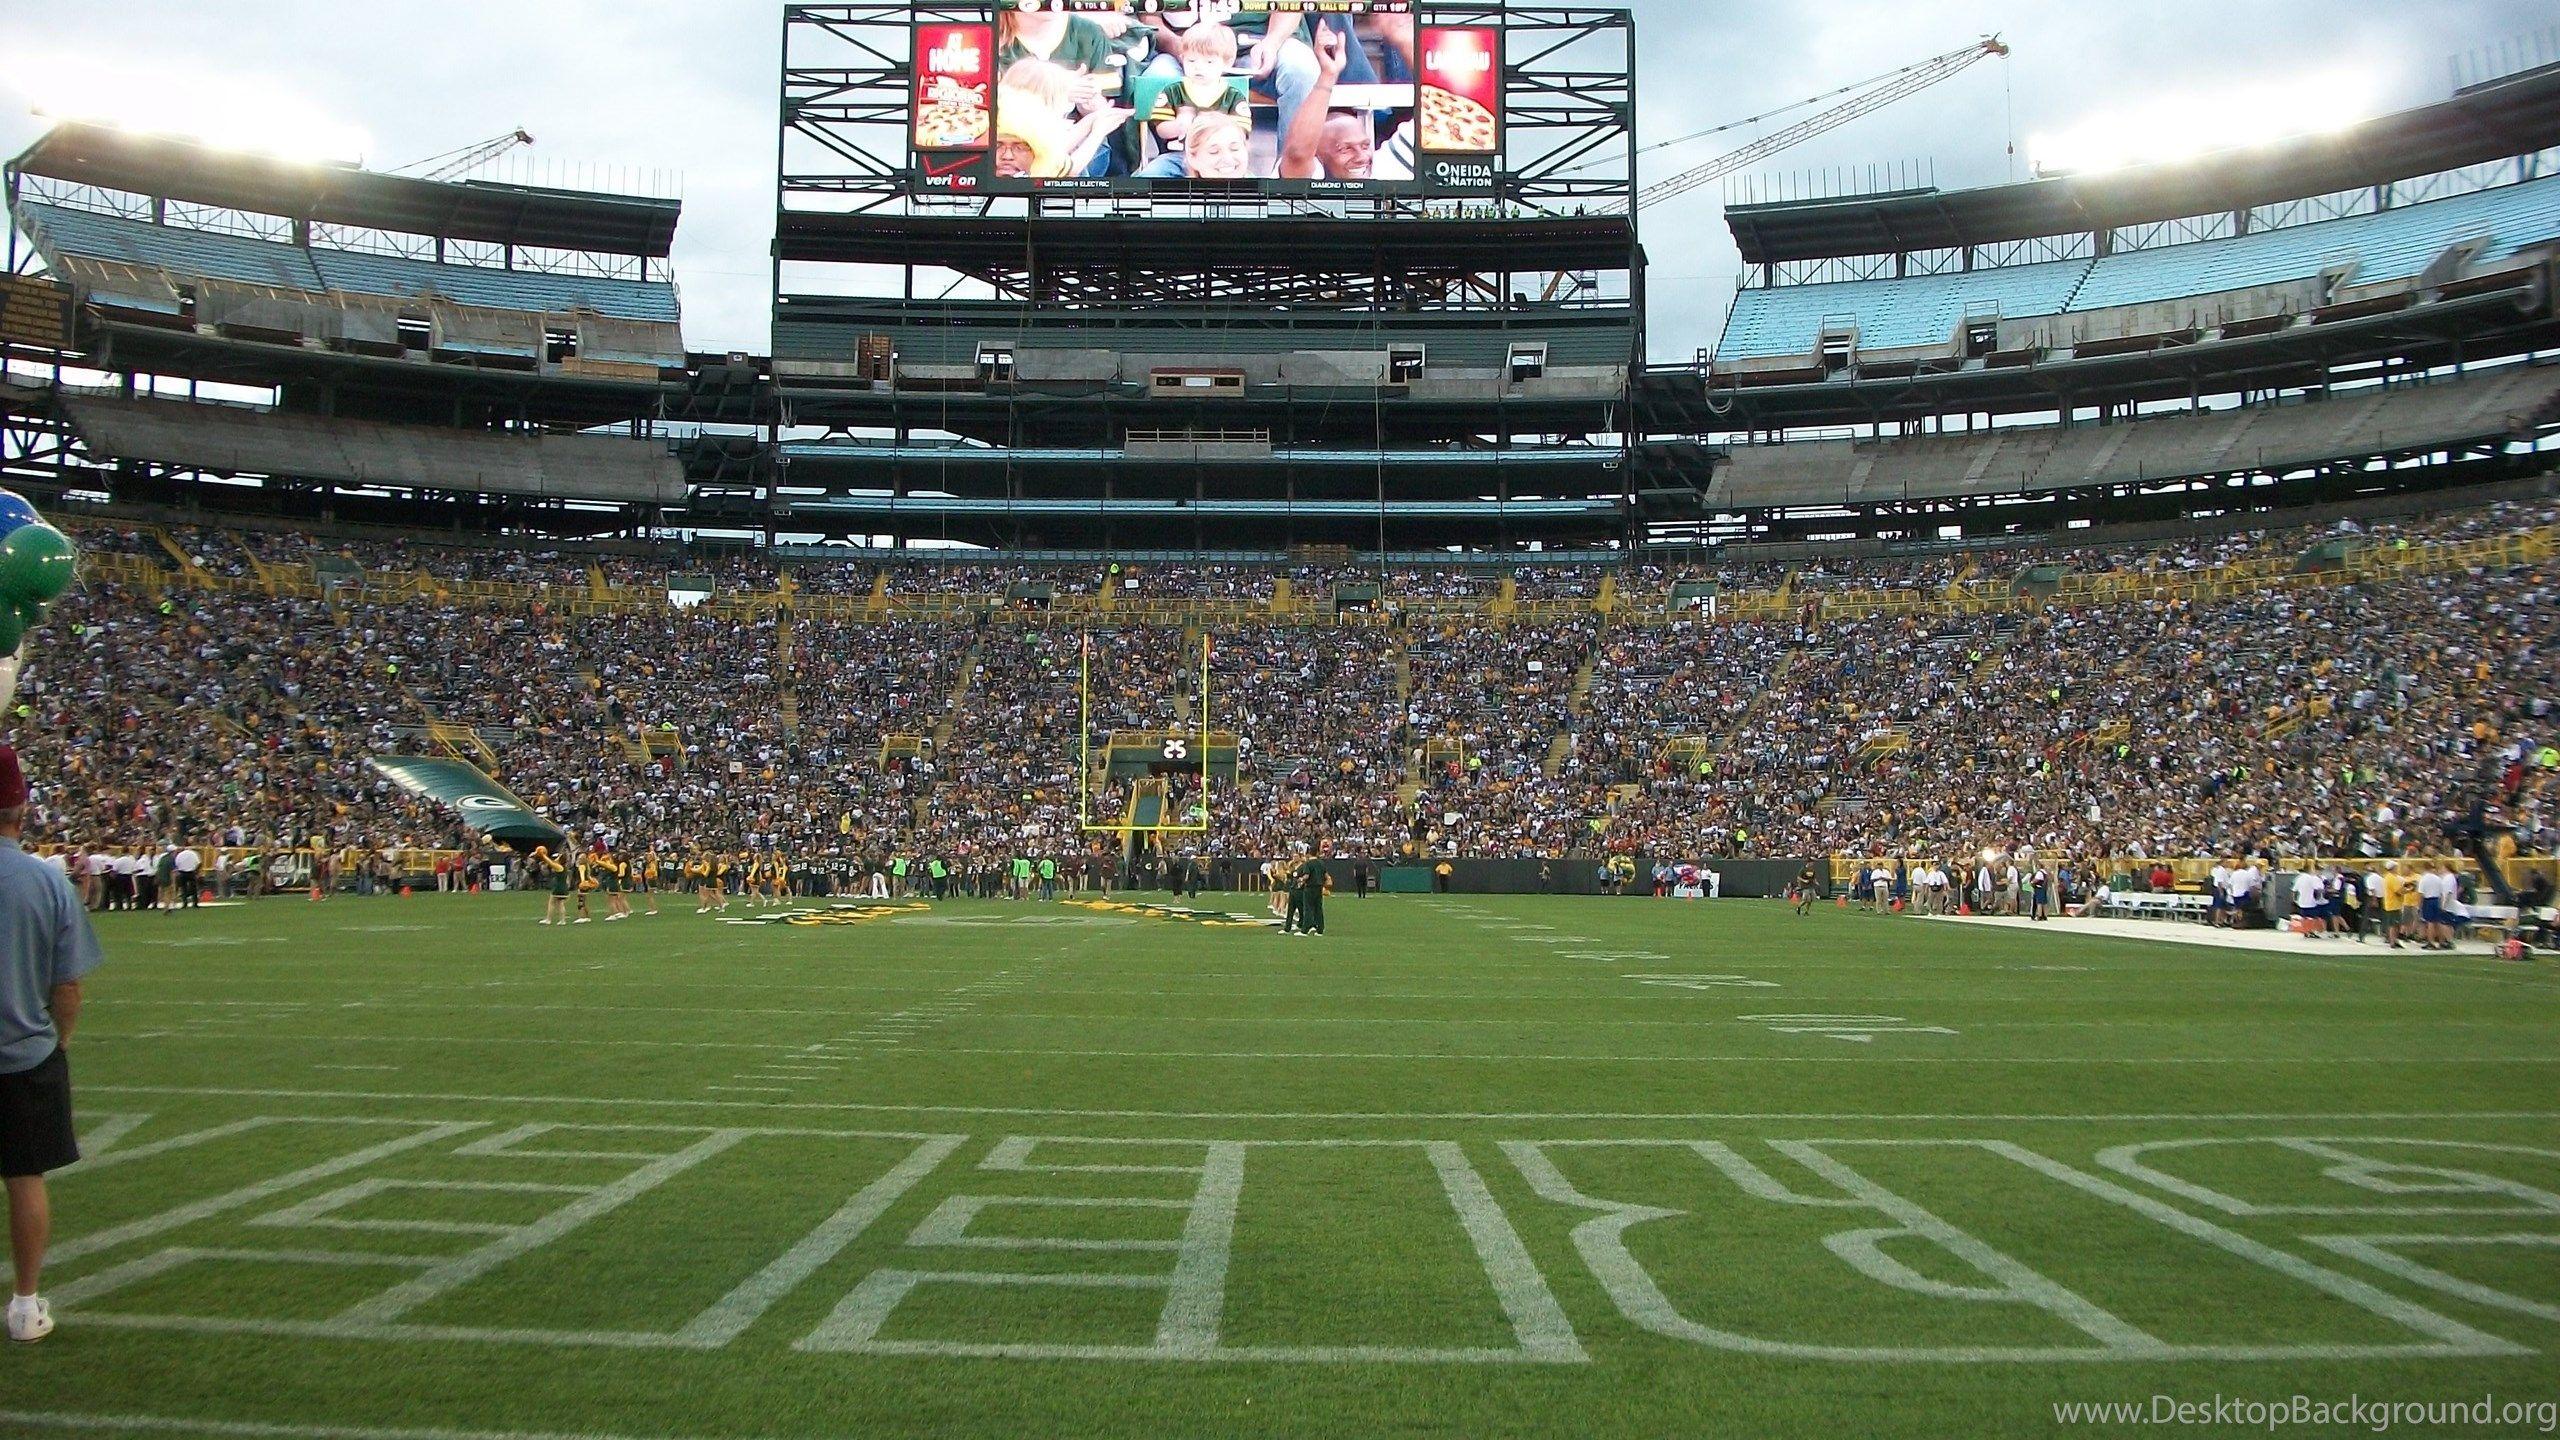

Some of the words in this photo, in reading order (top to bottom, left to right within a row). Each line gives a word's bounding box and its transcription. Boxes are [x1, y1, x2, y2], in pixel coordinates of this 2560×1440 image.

[1436, 162, 1492, 177] ONEIDA
[925, 174, 977, 187] verizon
[1450, 178, 1492, 187] NATION
[1164, 740, 1187, 759] 25
